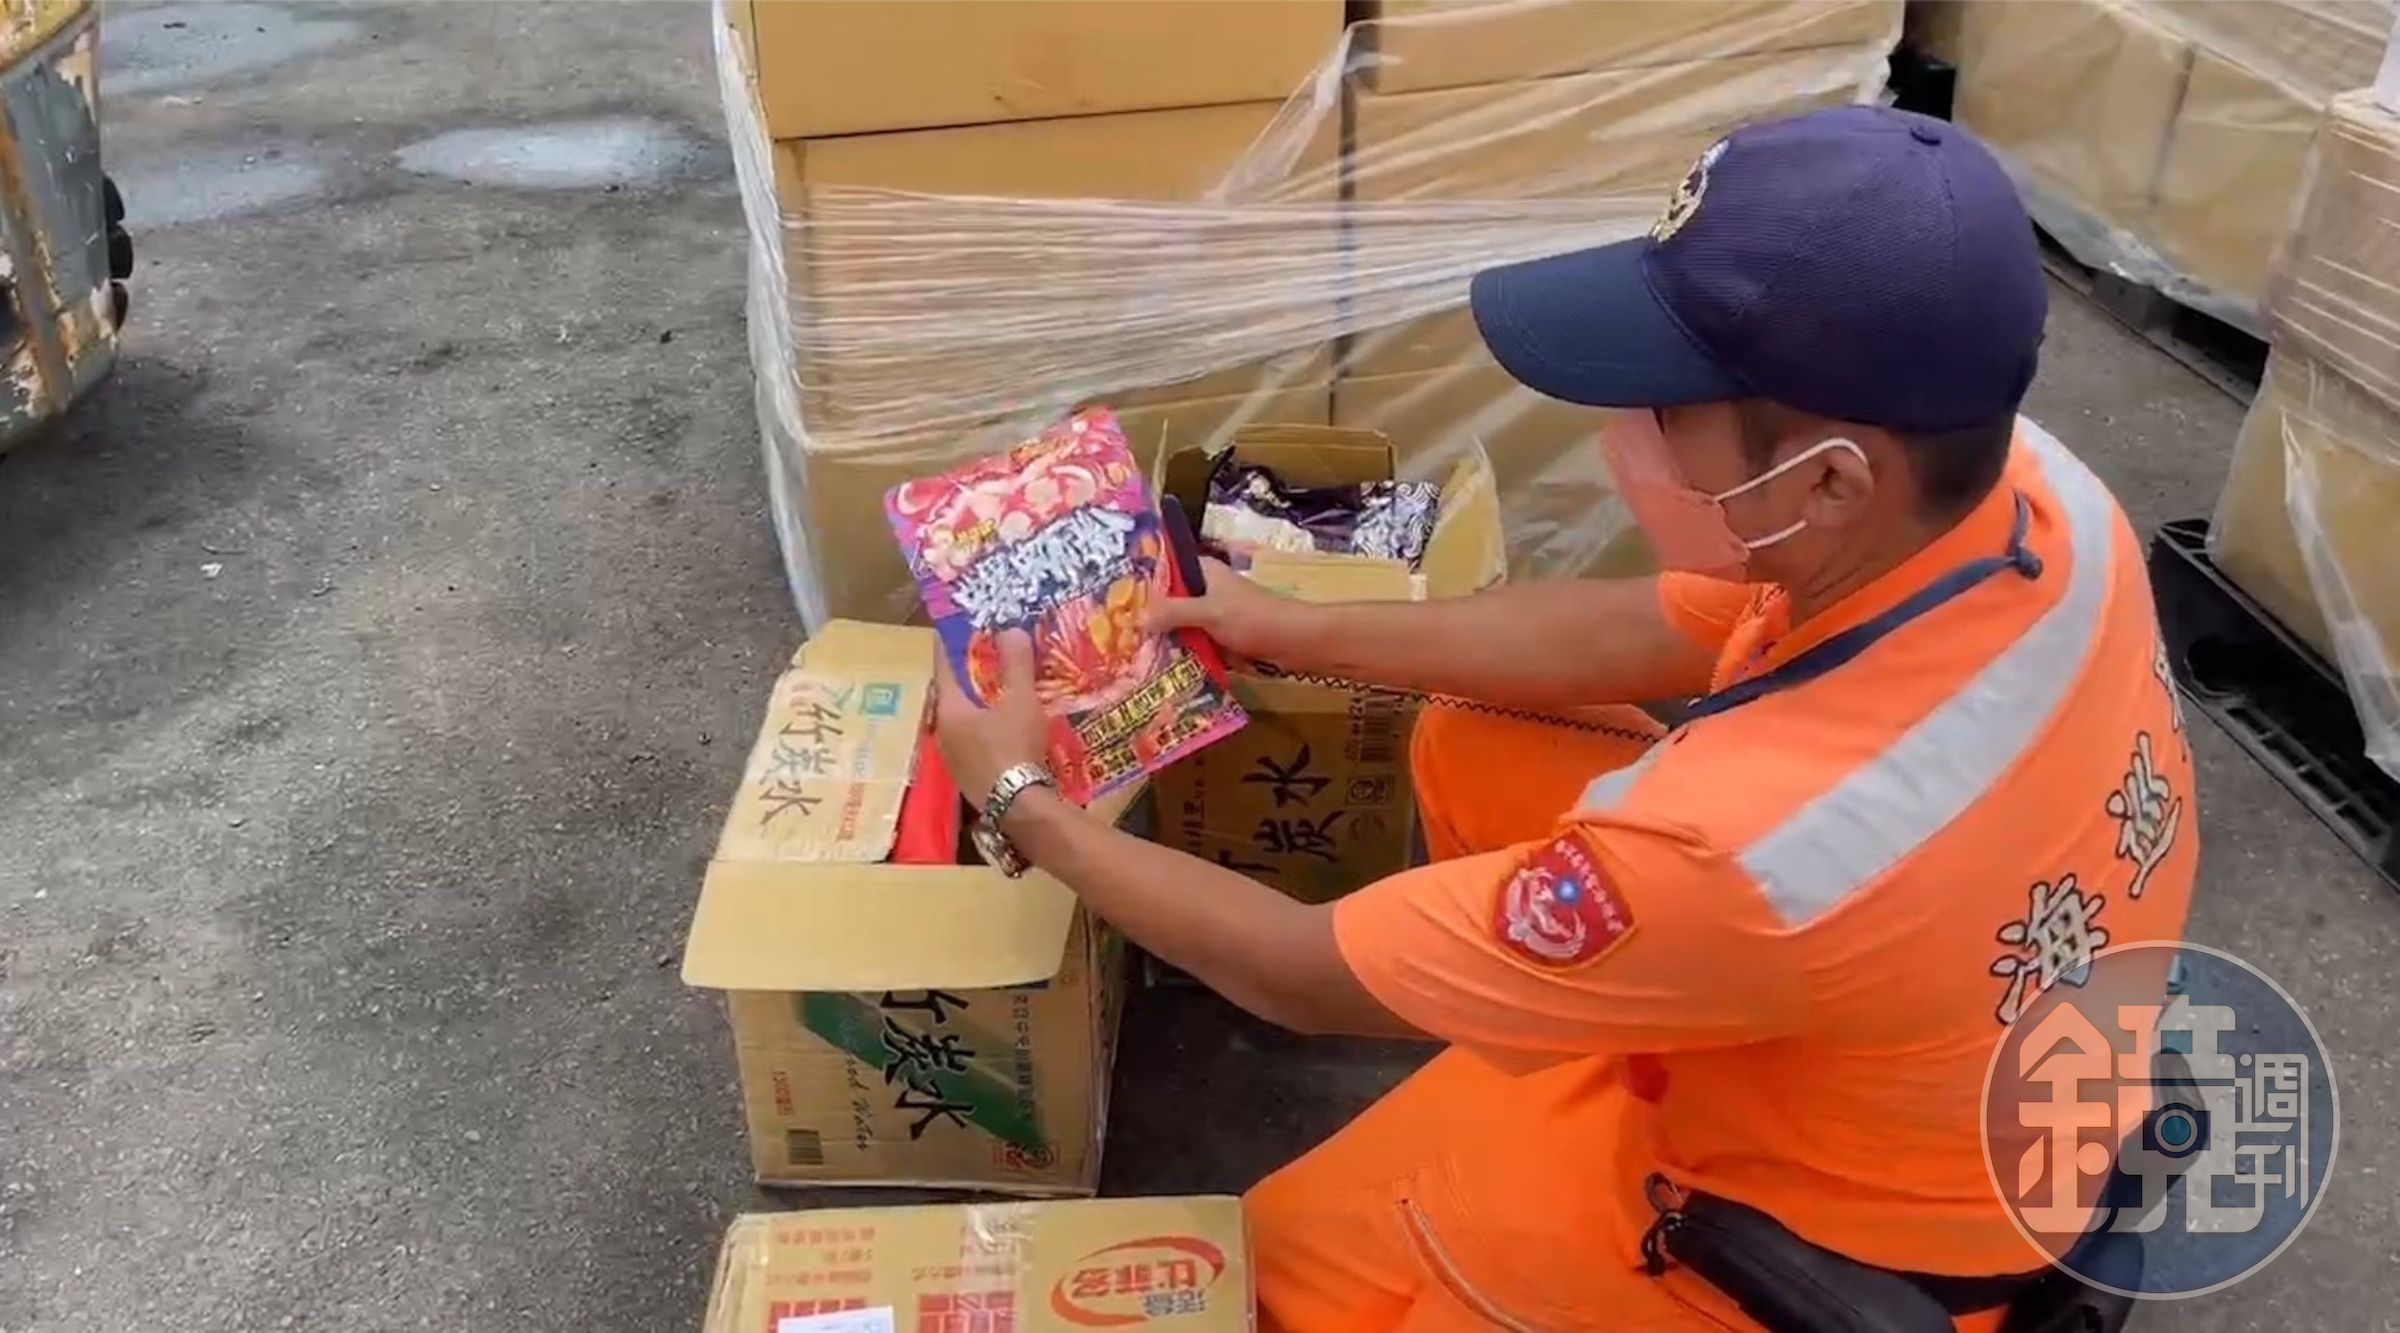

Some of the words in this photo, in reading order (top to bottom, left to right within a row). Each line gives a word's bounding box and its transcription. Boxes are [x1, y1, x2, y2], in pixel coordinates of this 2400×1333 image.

[759, 702, 844, 826] 竹炭水
[1990, 622, 2187, 1027] 海巡
[1070, 1260, 1197, 1298] 比菲多
